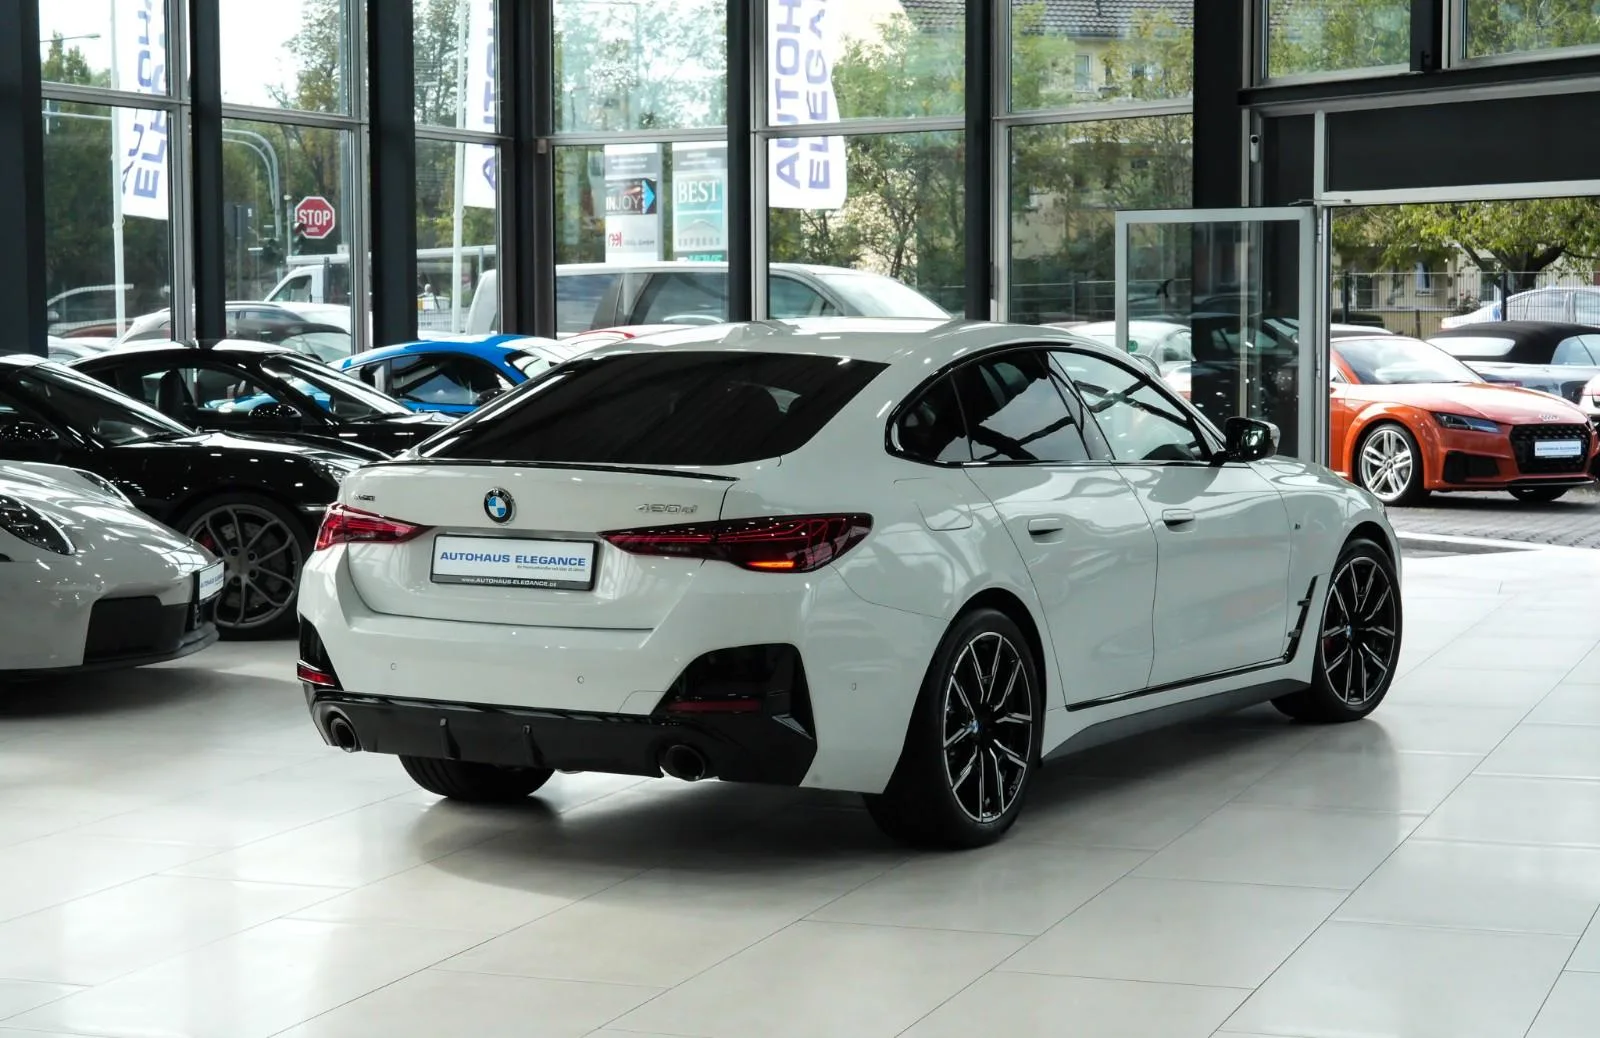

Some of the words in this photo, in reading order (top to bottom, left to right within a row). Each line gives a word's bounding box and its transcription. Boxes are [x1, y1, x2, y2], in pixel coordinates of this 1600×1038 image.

[678, 180, 717, 203] BEST
[606, 196, 640, 210] INJOY
[299, 209, 331, 225] STOP
[440, 552, 510, 562] AUTOHAUS
[515, 555, 586, 566] ELEGANCE
